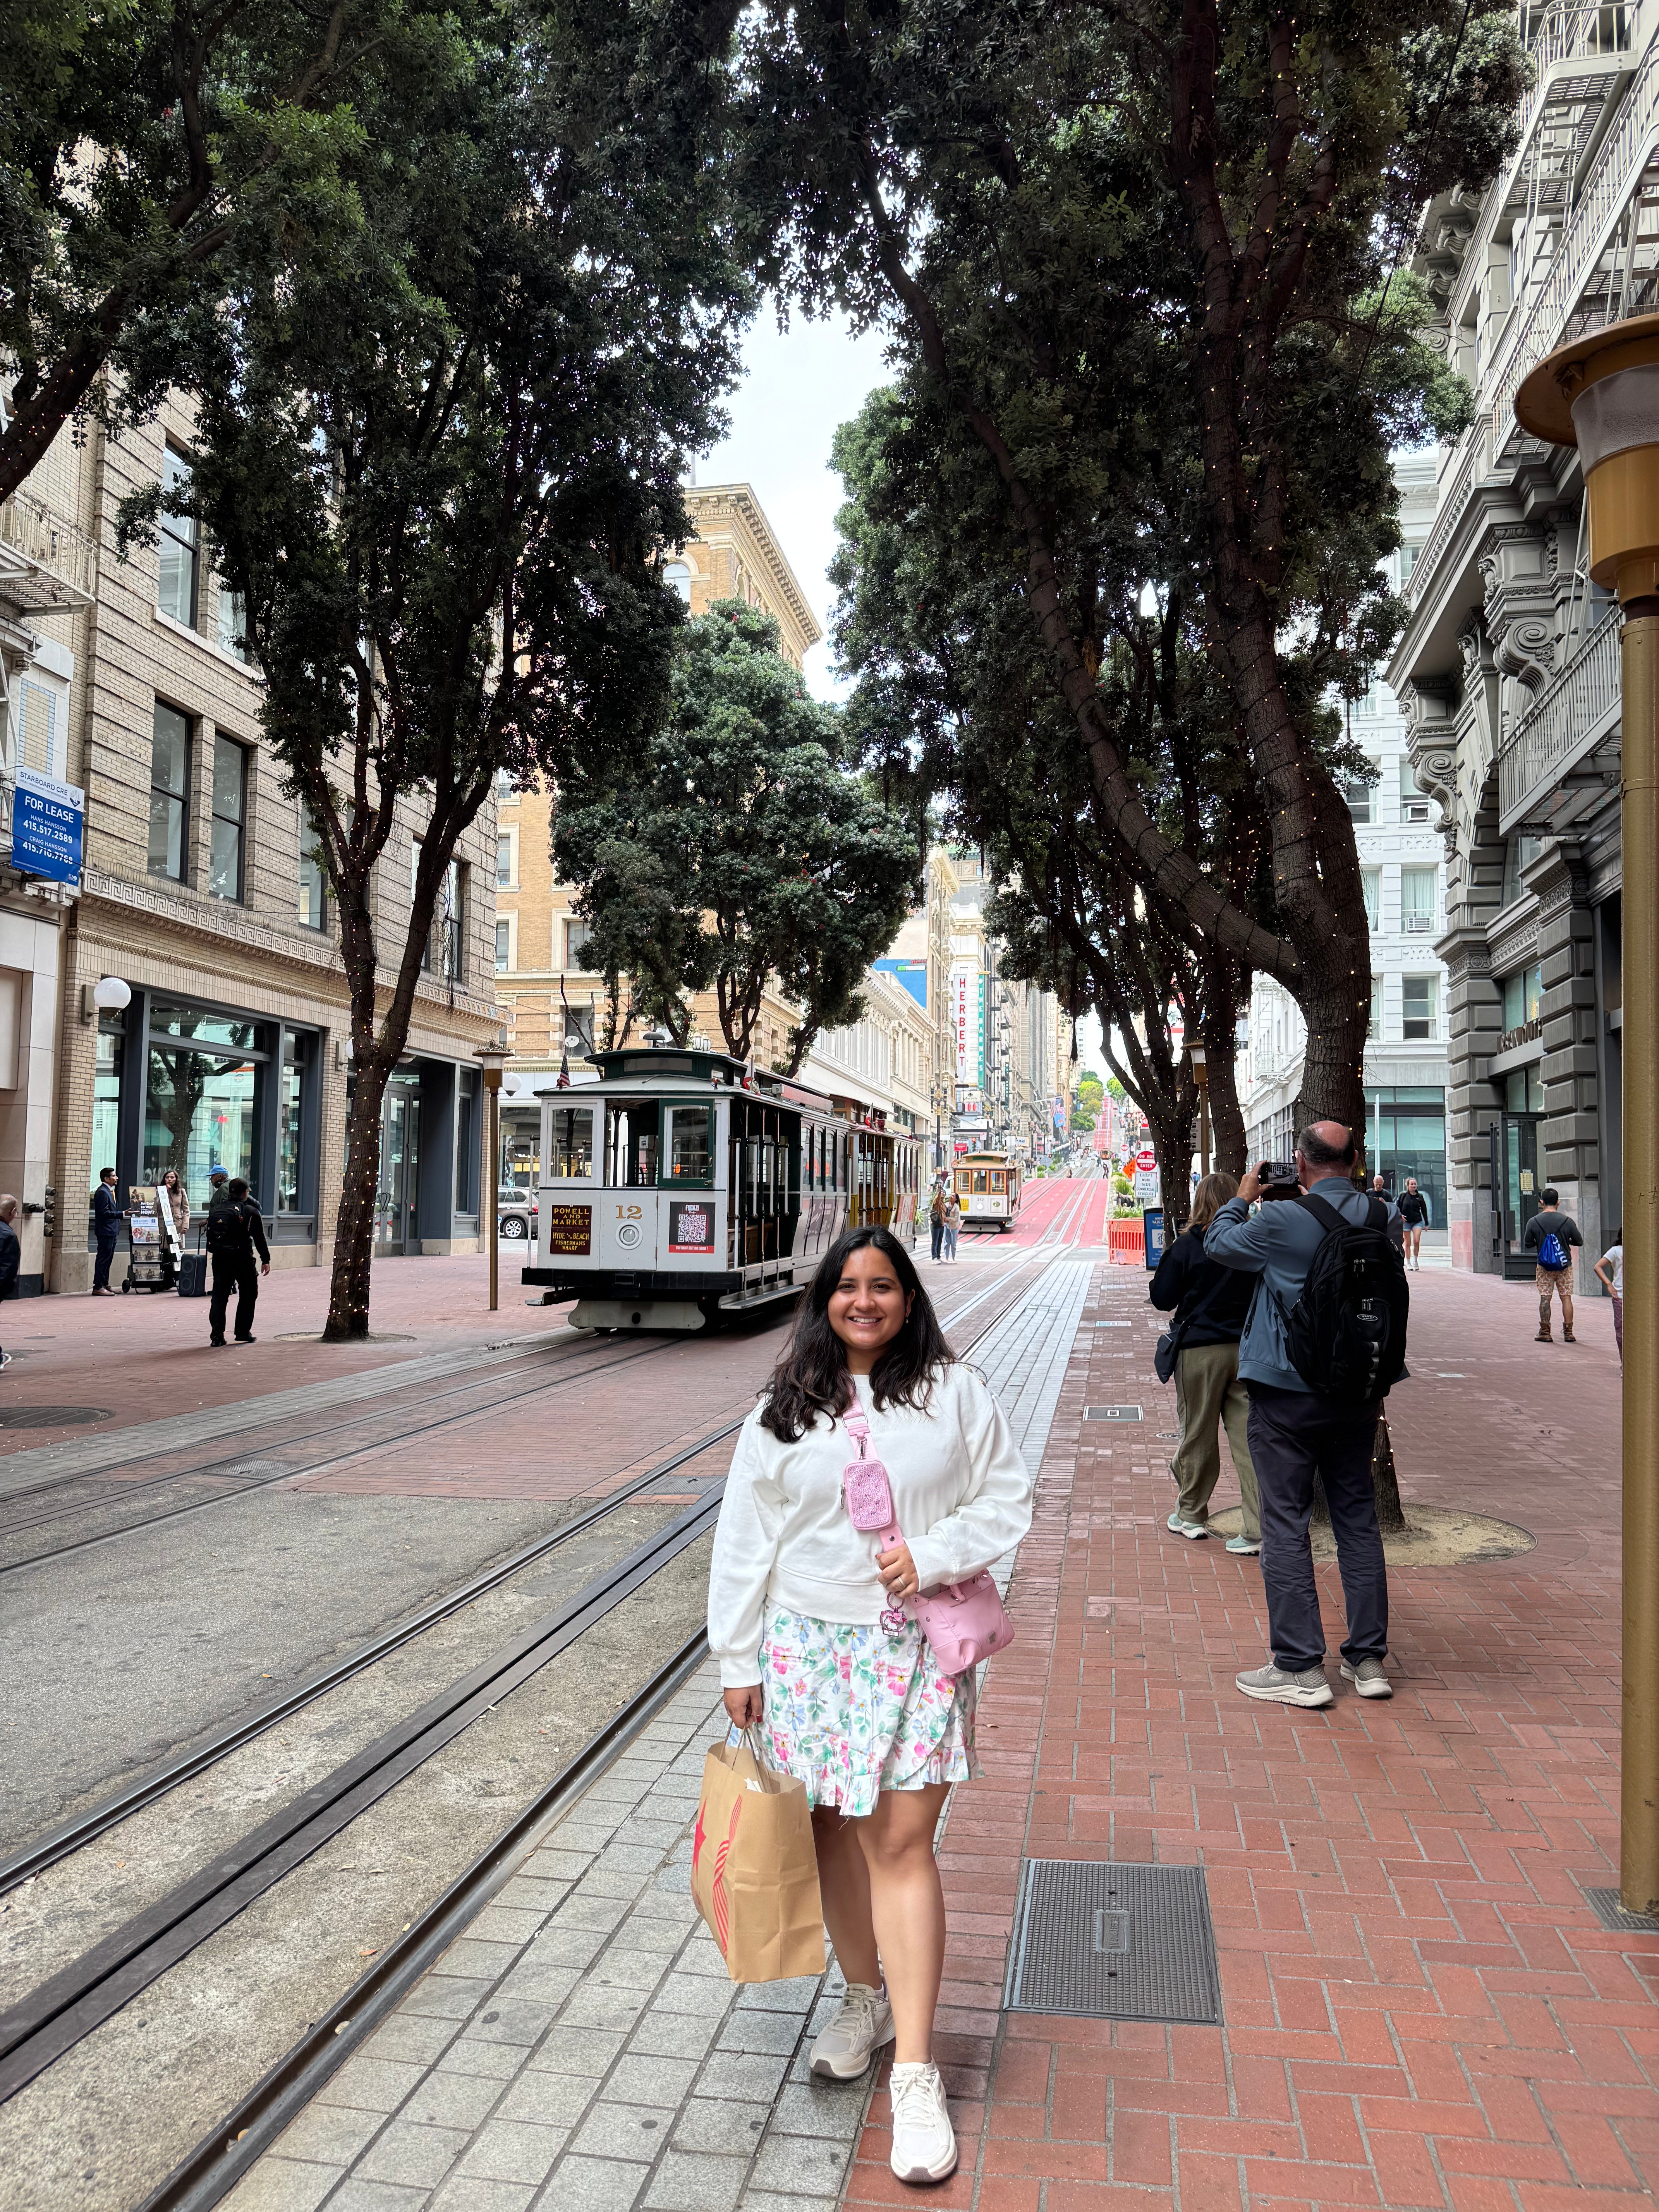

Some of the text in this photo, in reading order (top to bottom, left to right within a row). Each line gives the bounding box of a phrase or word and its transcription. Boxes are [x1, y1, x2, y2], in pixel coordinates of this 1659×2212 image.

[20, 771, 68, 796] STARBOARD CRE
[25, 795, 74, 823] FOR LEASE
[23, 819, 72, 844] 415.517.2589
[31, 814, 67, 832] HANS HANSSON
[29, 836, 67, 853] CRAIG HANSSON
[615, 1205, 642, 1219] 12
